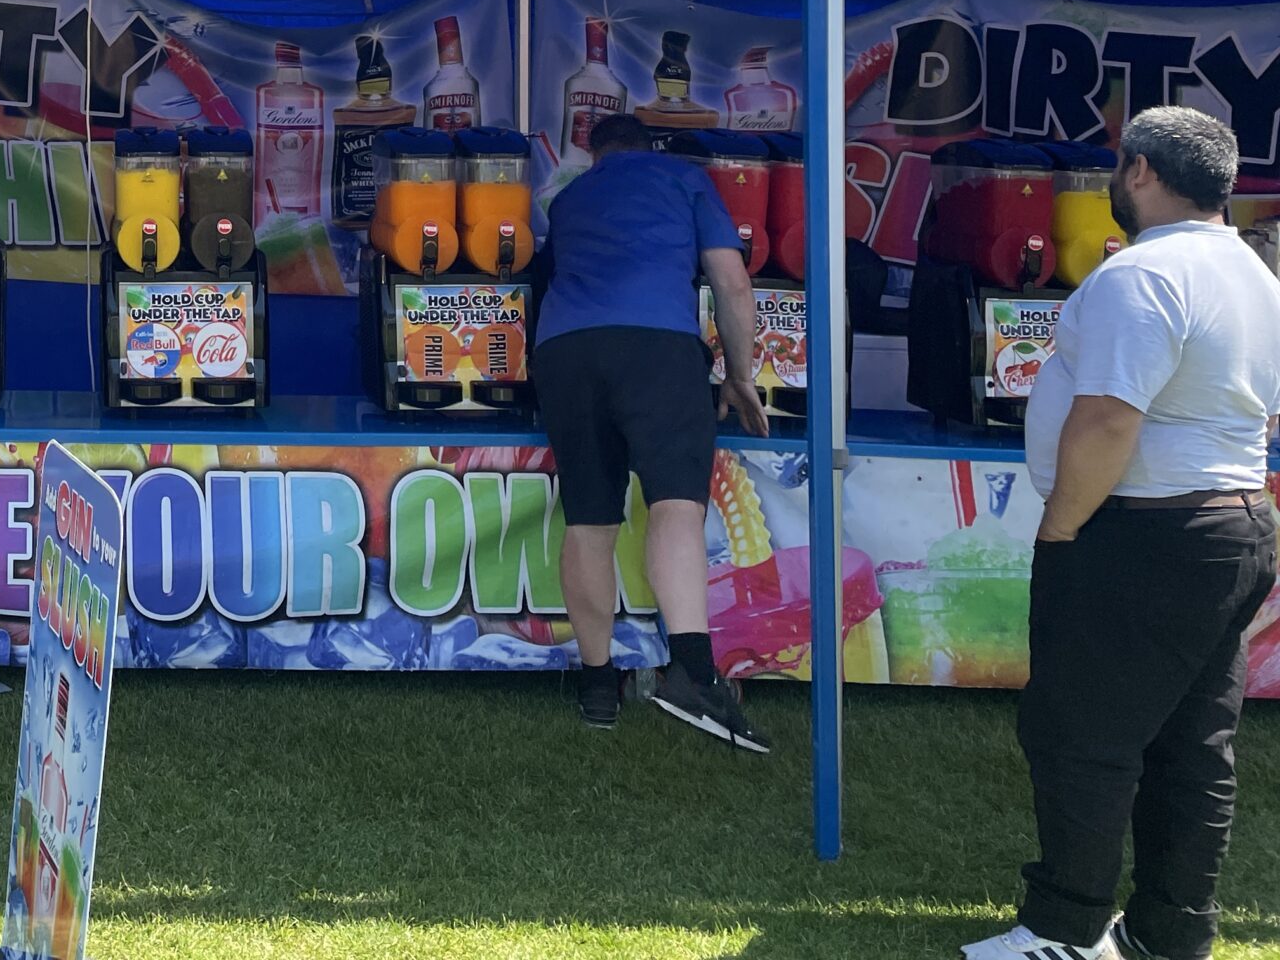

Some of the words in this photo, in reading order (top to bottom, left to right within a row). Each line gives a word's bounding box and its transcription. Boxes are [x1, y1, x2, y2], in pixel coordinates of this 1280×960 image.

[883, 15, 1280, 166] DIRTY
[430, 94, 474, 108] SMIRNOFF
[570, 93, 620, 110] SMIRNOFF
[343, 138, 368, 154] JACK
[151, 293, 193, 307] HOLD
[194, 293, 225, 307] CUP
[427, 295, 471, 309] HOLD
[471, 295, 503, 309] CUP
[756, 300, 776, 313] LD
[131, 307, 181, 322] UNDER
[183, 307, 212, 322] THE
[213, 307, 242, 322] TAP
[407, 309, 458, 323] UNDER
[460, 309, 491, 323] THE
[491, 309, 520, 323] TAP
[766, 314, 795, 329] THE
[1019, 310, 1060, 324] HOLD
[999, 324, 1051, 339] UNDER
[131, 338, 154, 350] Red
[154, 338, 176, 349] Bull
[196, 333, 240, 365] Cola
[425, 335, 443, 376] PRIME
[488, 333, 507, 375] PRIME
[56, 479, 94, 564] GIN
[92, 526, 100, 549] to
[100, 536, 117, 567] your
[97, 467, 367, 622] OUR
[38, 534, 109, 691] SLUSH
